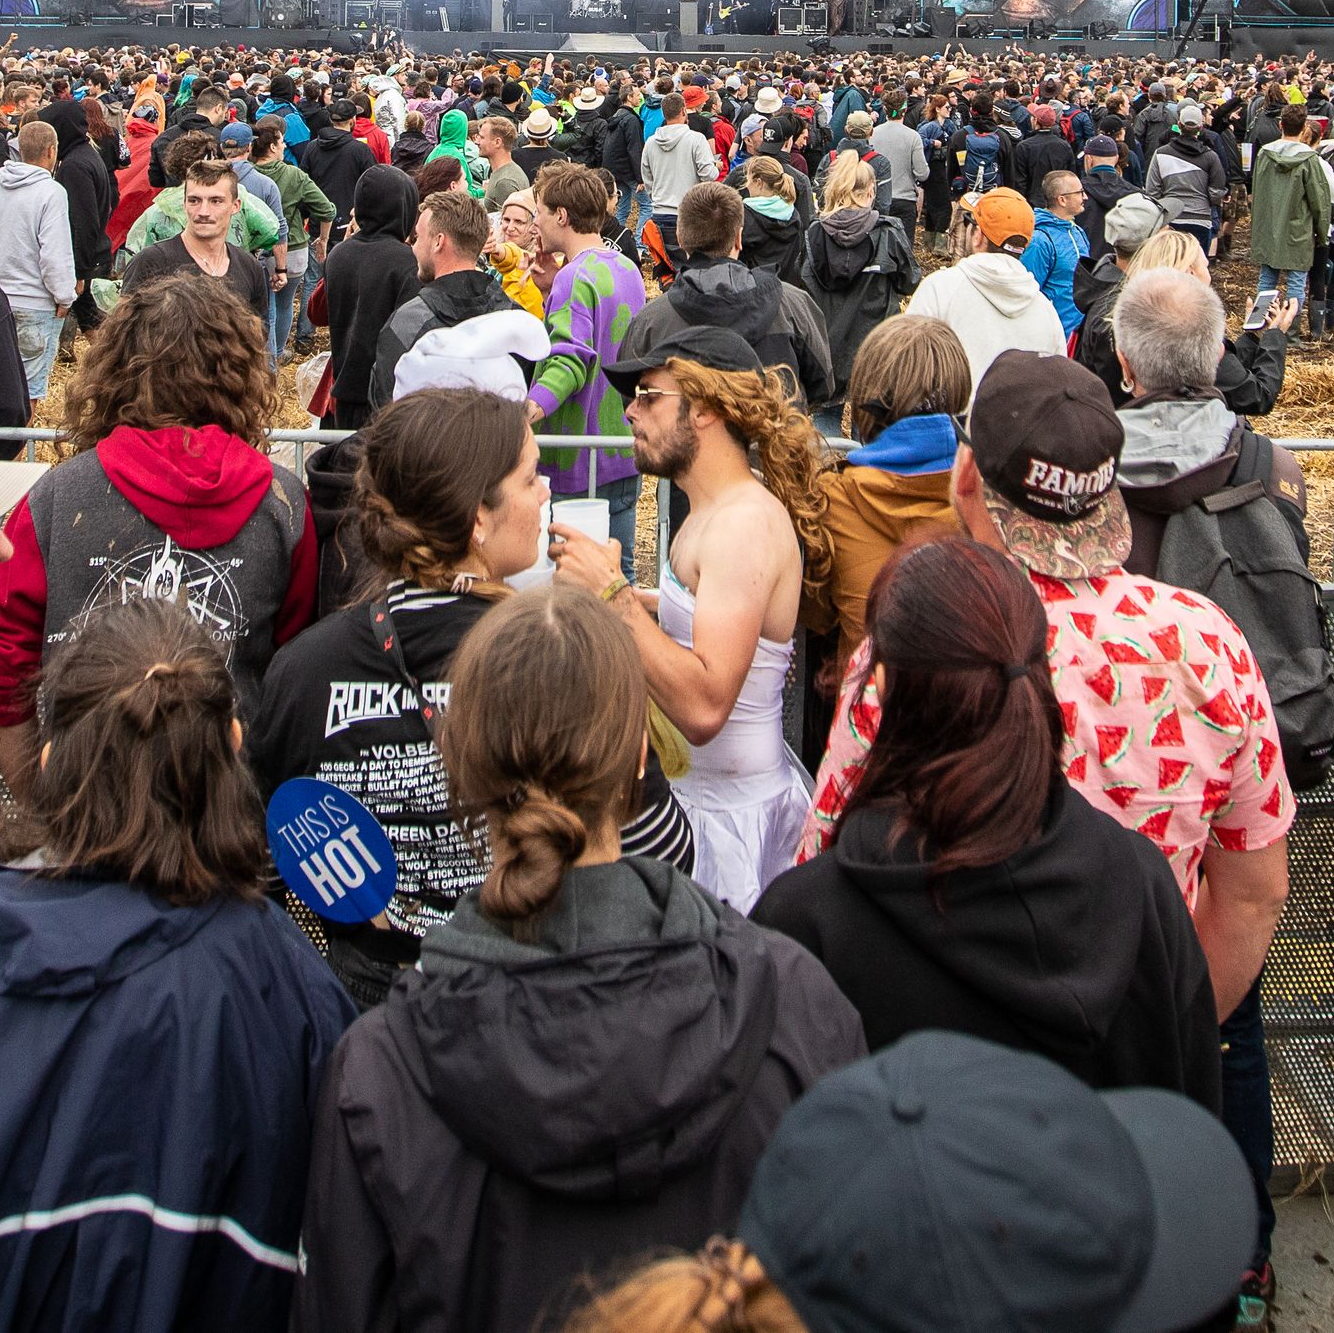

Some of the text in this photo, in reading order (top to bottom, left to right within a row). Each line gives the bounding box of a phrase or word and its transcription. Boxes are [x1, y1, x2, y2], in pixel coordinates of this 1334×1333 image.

[325, 681, 402, 738] ROCK
[402, 688, 419, 710] IM
[372, 741, 438, 760] VOLBEA
[320, 762, 332, 771] 100
[334, 762, 354, 772] GECS
[370, 761, 387, 771] DAY
[388, 759, 400, 769] TO
[369, 770, 392, 781] BILLY
[394, 767, 424, 780] TALENT
[368, 781, 401, 792] BULLET
[402, 778, 419, 789] FOR
[420, 776, 433, 786] MY
[277, 794, 349, 857] THIS IS
[299, 824, 382, 907] HOT
[427, 869, 454, 881] STICK
[455, 866, 468, 876] TO
